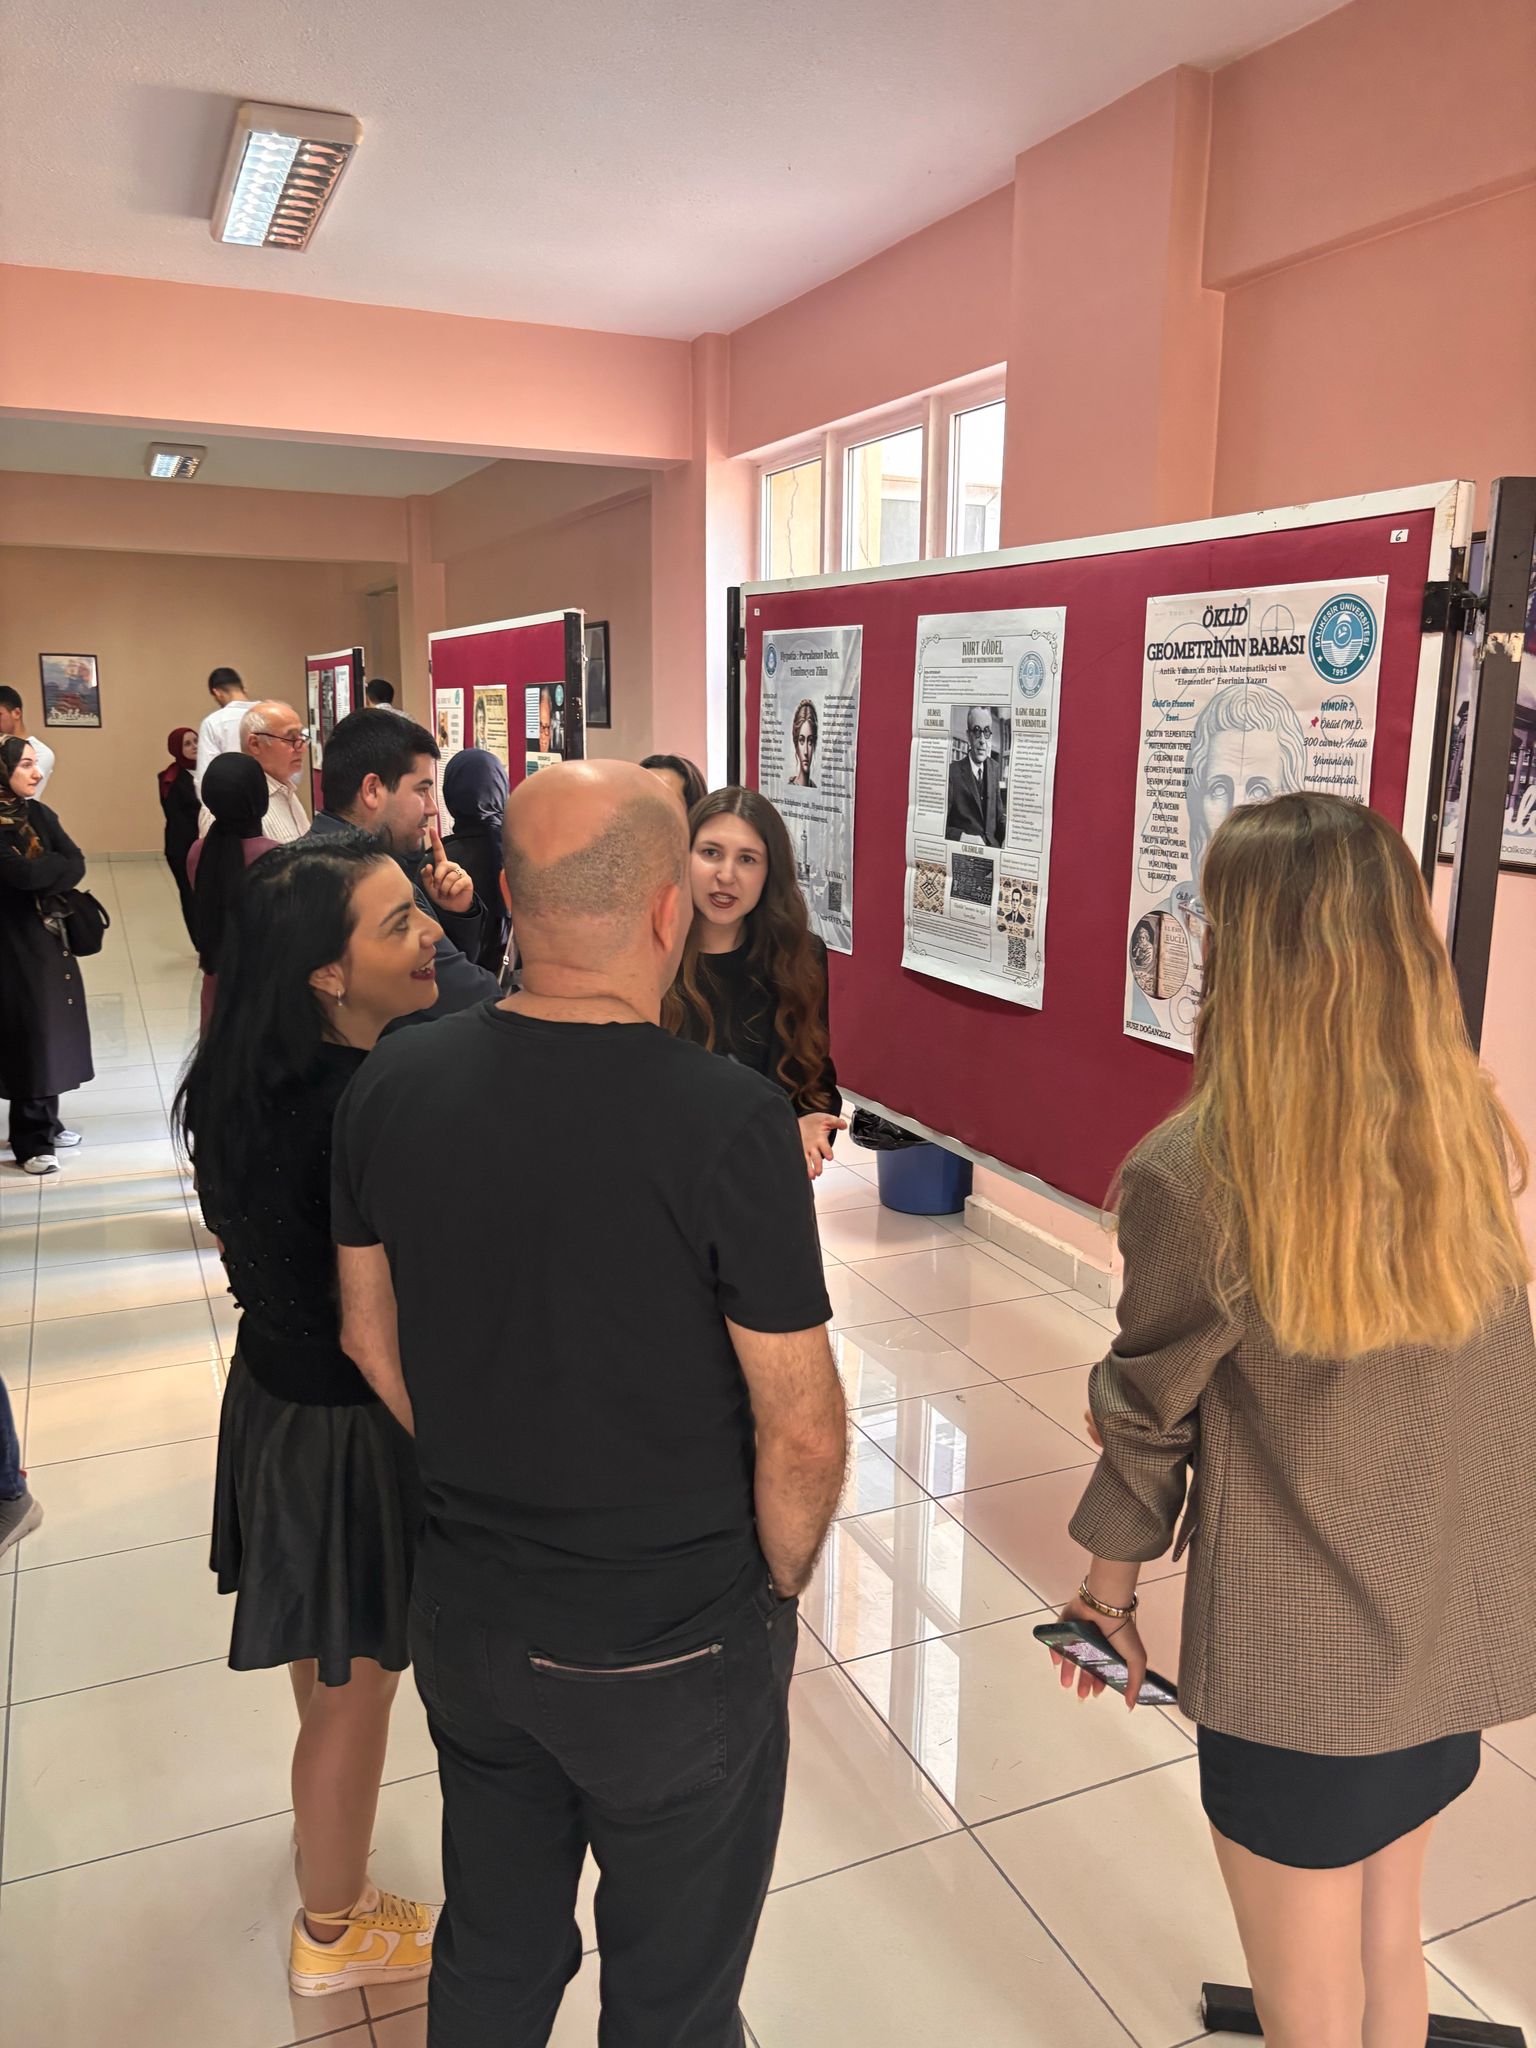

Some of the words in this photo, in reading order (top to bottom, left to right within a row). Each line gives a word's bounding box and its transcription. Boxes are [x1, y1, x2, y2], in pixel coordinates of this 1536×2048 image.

[1395, 530, 1403, 542] 6
[1202, 603, 1248, 628] ÖKLİD
[962, 641, 980, 656] KURT
[981, 638, 1004, 656] GÖDEL
[1146, 635, 1247, 661] GEOMETRİNİN
[1249, 635, 1306, 657] BABASI
[1159, 666, 1176, 675] Antik
[1206, 664, 1227, 675] Büyük
[1228, 664, 1277, 674] Matematikçisi
[1332, 668, 1348, 676] 1992
[1217, 677, 1244, 685] Eserinin
[1172, 699, 1195, 708] Efsanevi
[1320, 699, 1348, 711] KİMDİR
[1166, 713, 1180, 721] Eseri
[1303, 737, 1319, 747] 300
[1346, 738, 1368, 748] Antik
[1126, 1020, 1139, 1031] BUSE
